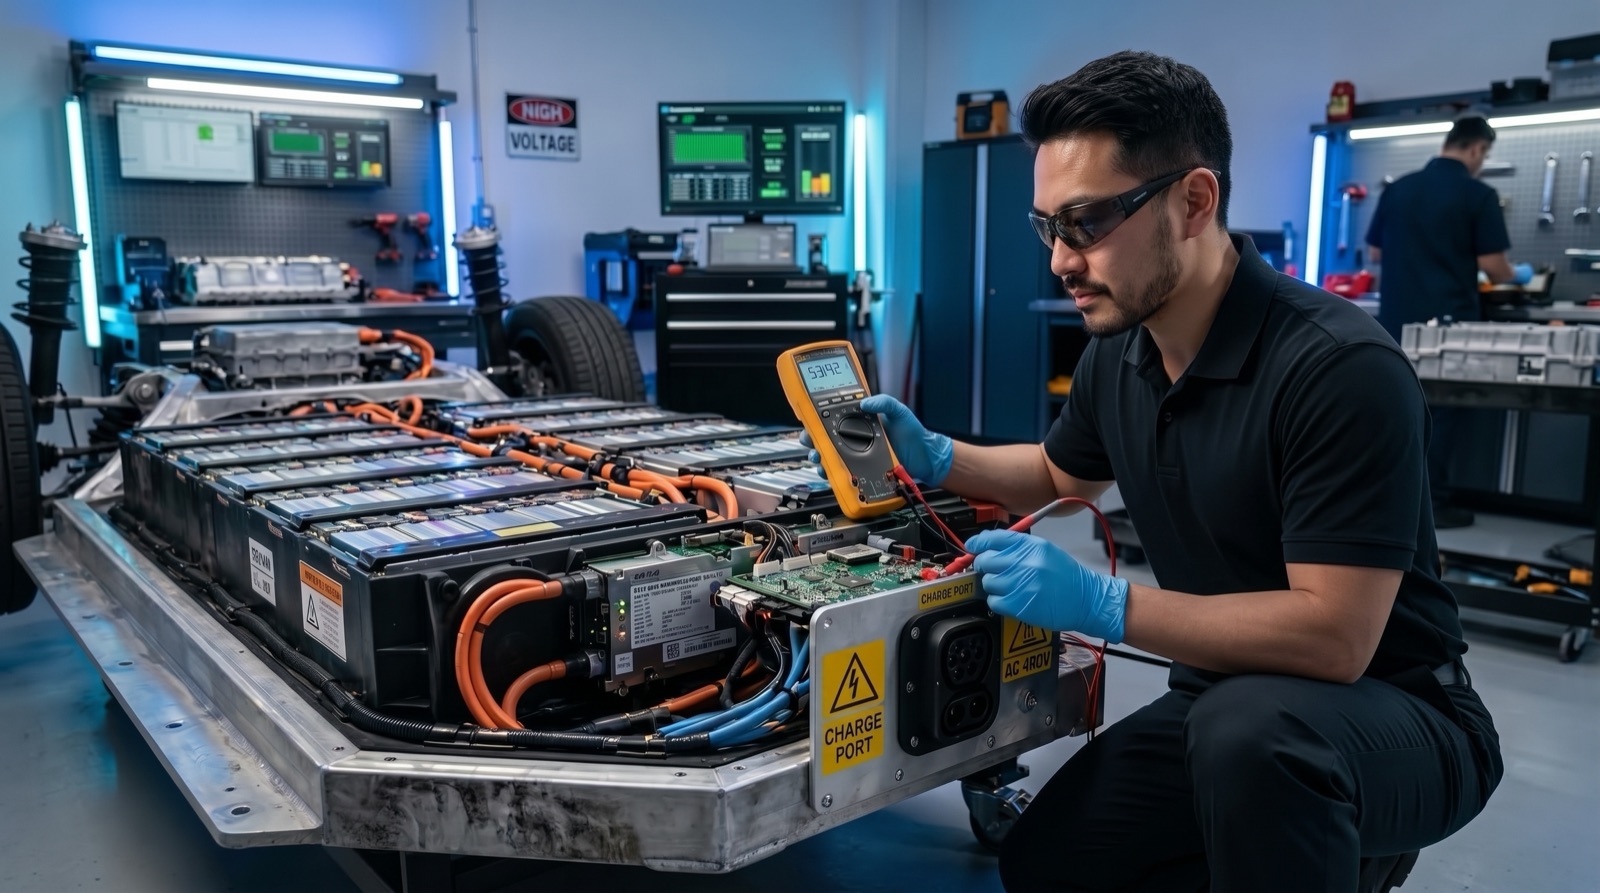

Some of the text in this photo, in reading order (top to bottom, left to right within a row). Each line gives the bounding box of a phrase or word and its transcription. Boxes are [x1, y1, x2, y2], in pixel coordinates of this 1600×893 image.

[510, 132, 575, 153] VOLTAGE
[921, 582, 974, 605] CHARGE PORT
[824, 711, 882, 746] CHARGE
[836, 735, 874, 764] PORT
